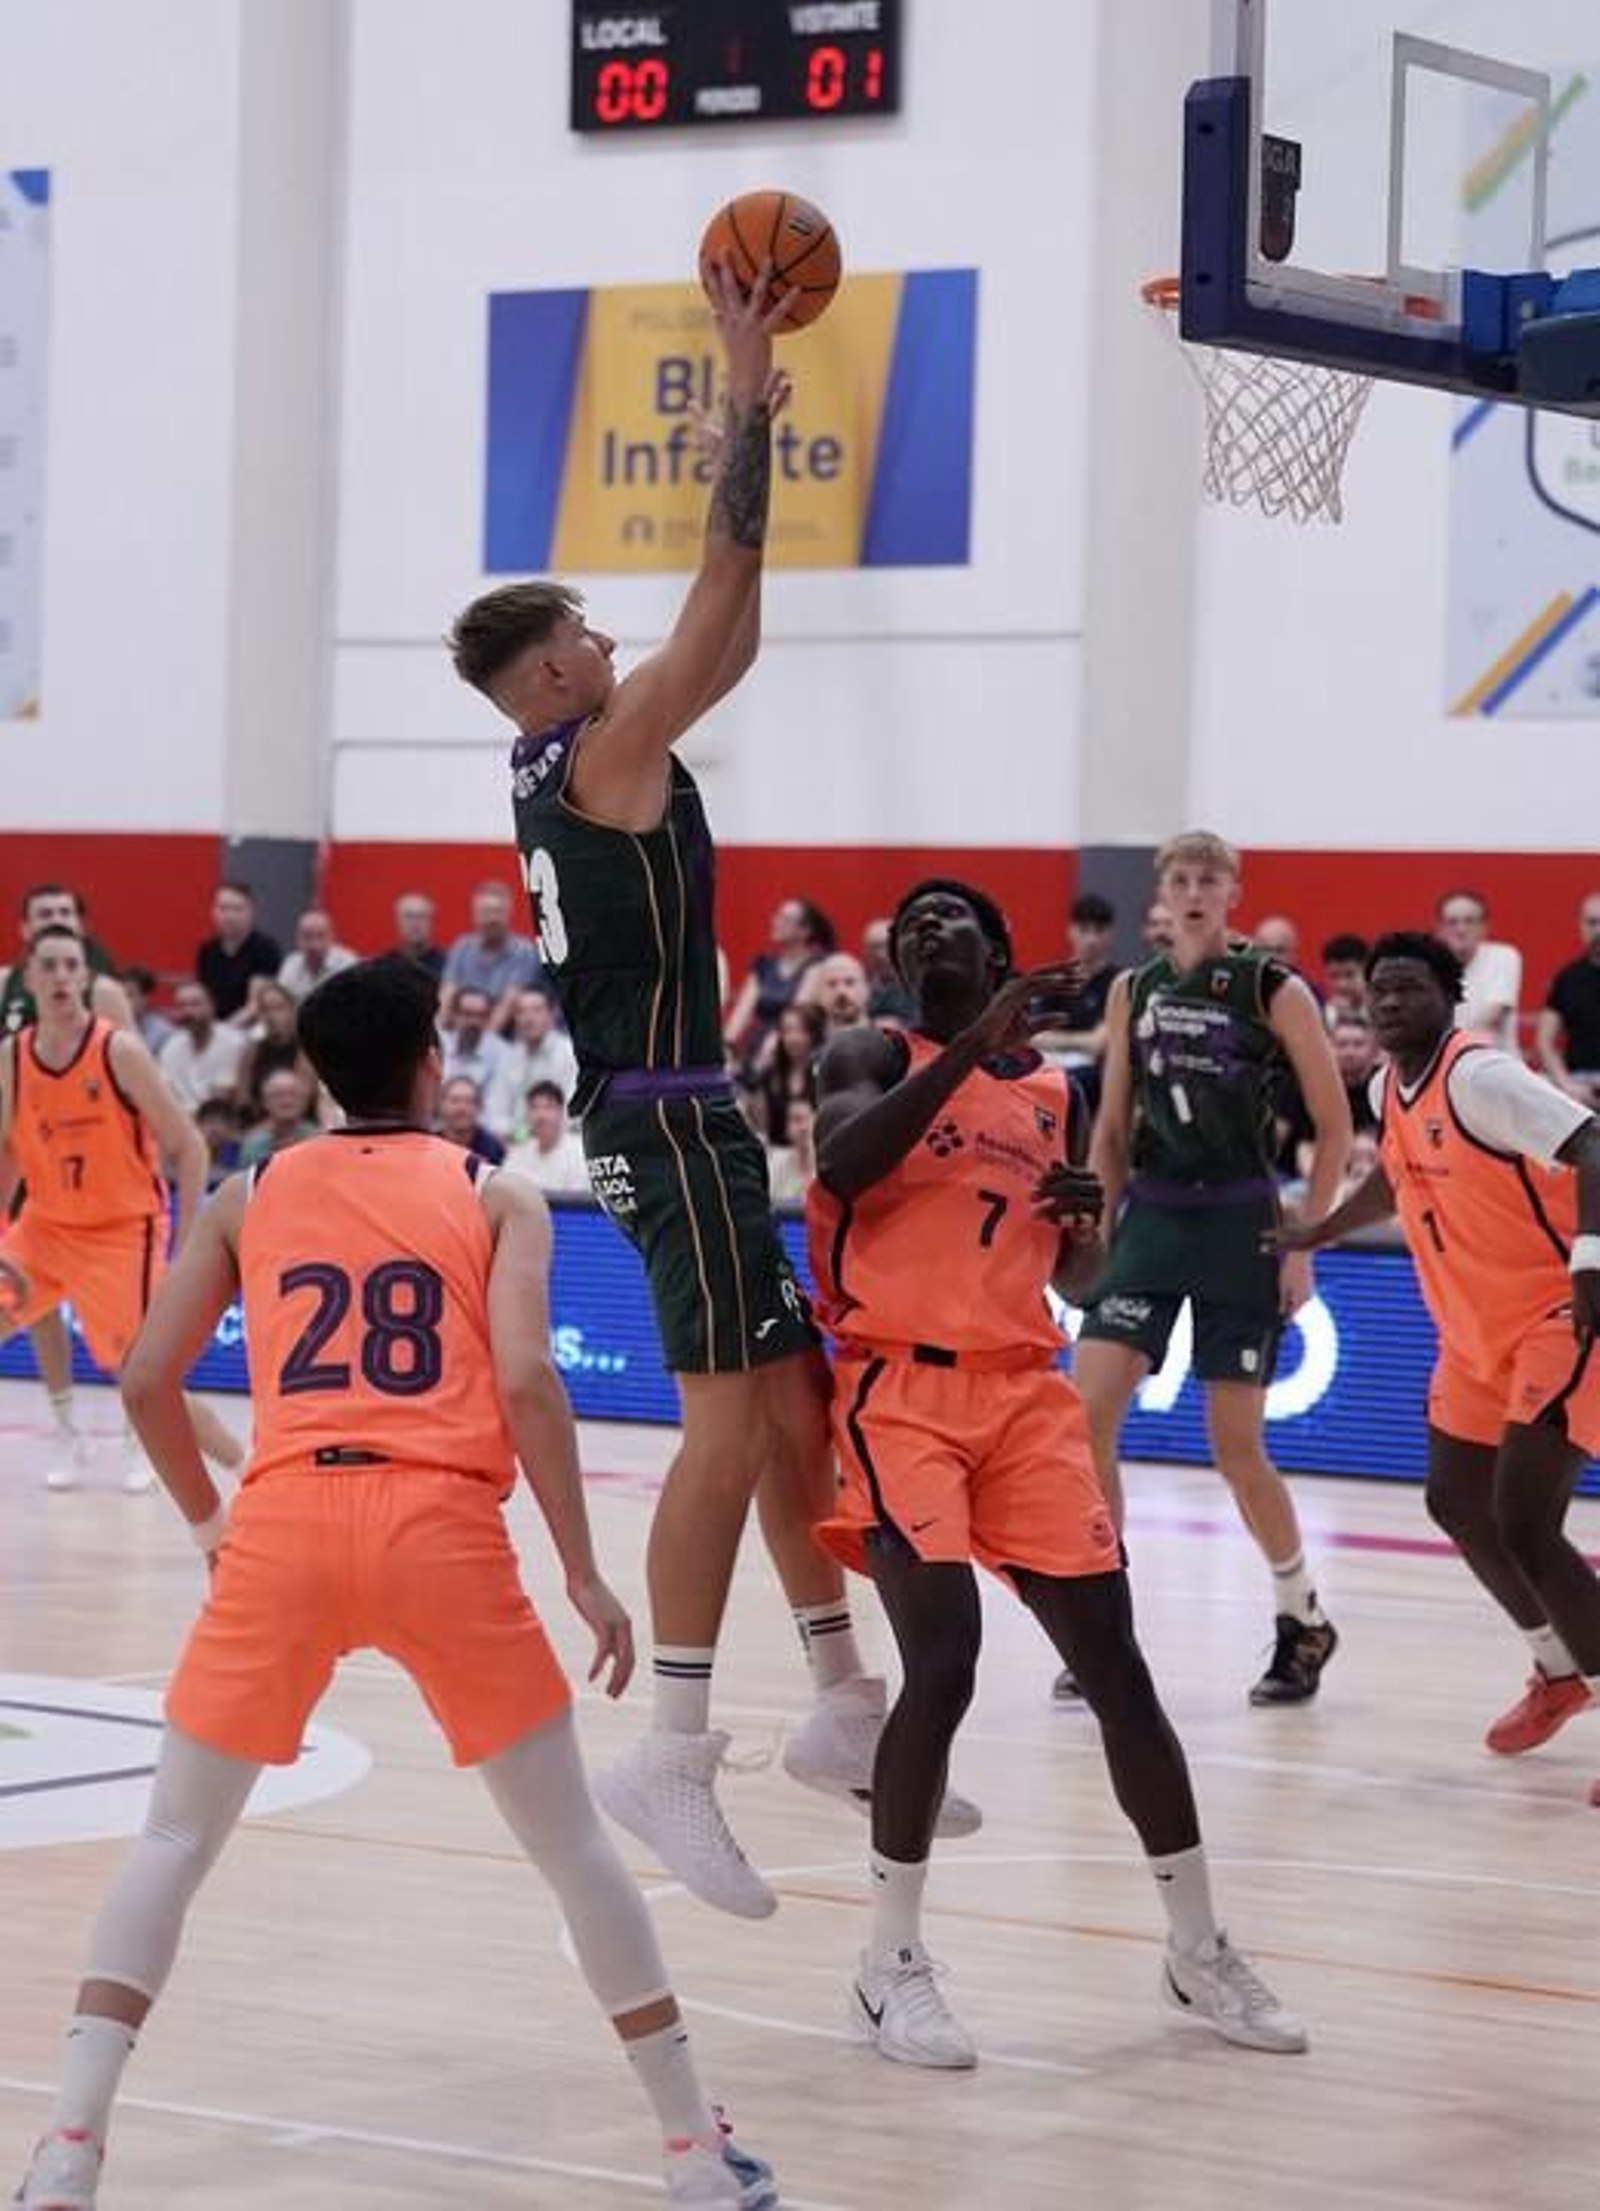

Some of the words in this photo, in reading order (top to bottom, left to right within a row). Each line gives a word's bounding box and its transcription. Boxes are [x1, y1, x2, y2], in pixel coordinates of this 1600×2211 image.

[581, 19, 667, 48] LOCAL
[597, 59, 668, 122] 00
[807, 47, 882, 107] 01
[519, 846, 568, 965] 3
[1171, 1083, 1193, 1123] 1
[977, 1188, 1008, 1248] 7
[1423, 1209, 1447, 1253] 1
[279, 1259, 443, 1397] 28
